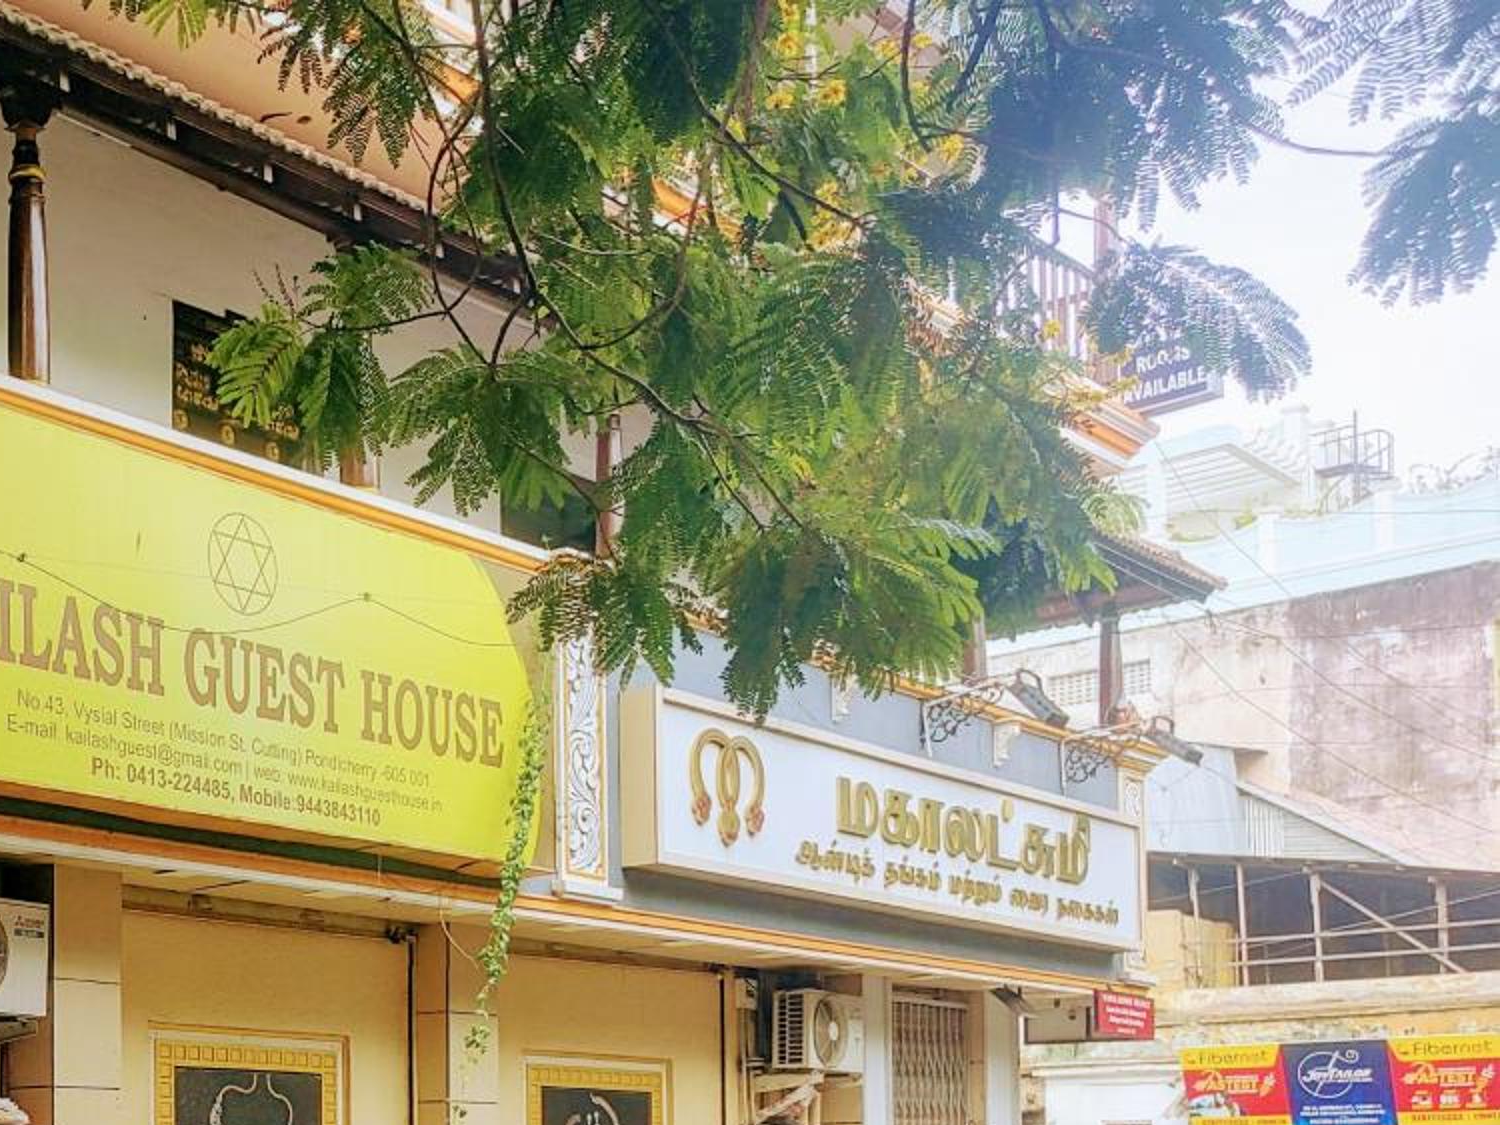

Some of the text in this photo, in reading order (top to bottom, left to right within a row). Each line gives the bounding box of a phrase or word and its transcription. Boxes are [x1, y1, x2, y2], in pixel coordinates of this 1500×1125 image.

[183, 627, 345, 734] GUEST
[360, 670, 505, 768] HOUSE
[74, 702, 117, 727] Vysial
[122, 711, 164, 735] Street
[169, 721, 225, 747] (Mission
[252, 738, 302, 766] Cutting)
[305, 749, 378, 778] Pondicherry
[91, 758, 120, 781] Ph:
[288, 773, 443, 812] www.kailashguesthouse.in
[947, 869, 1002, 907] மற்றும்
